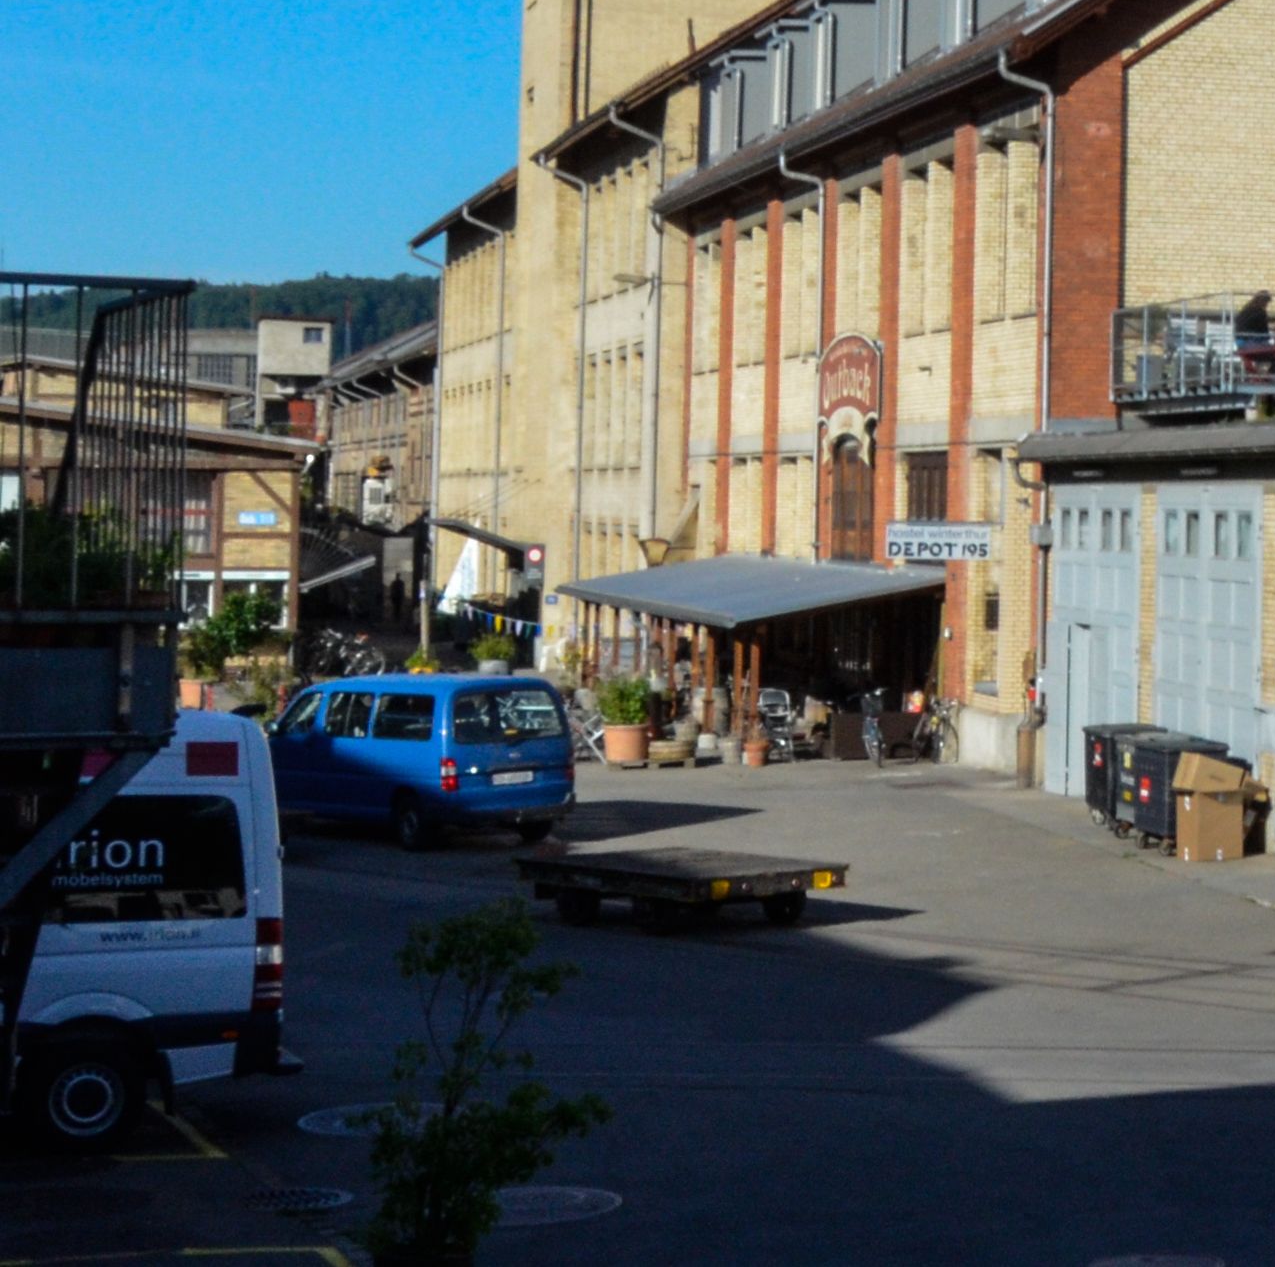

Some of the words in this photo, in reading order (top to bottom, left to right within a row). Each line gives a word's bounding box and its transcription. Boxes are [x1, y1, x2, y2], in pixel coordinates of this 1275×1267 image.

[888, 527, 924, 539] hostel
[927, 528, 988, 539] winterthur
[888, 541, 959, 557] DEPOT
[961, 543, 988, 557] 195
[56, 829, 165, 869] rion
